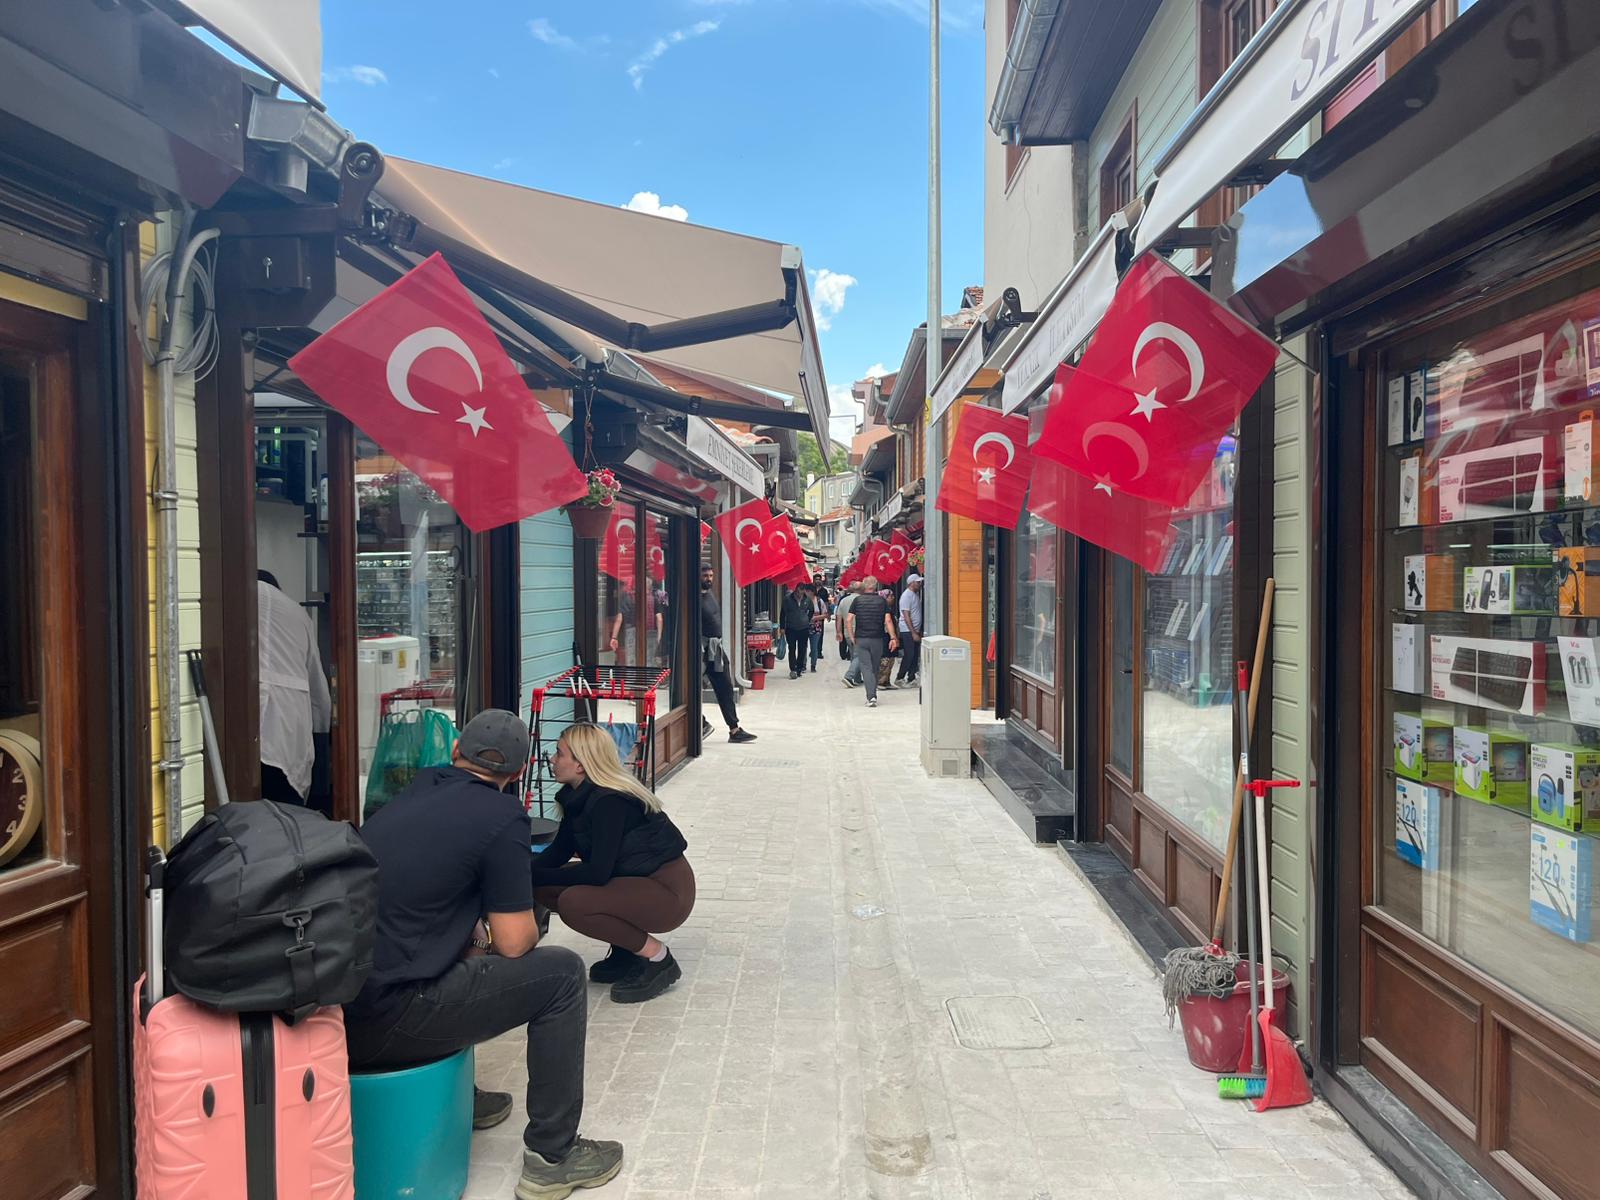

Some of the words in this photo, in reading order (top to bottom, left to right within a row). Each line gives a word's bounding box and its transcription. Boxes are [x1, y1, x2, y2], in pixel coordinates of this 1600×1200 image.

[12, 767, 23, 784] 2
[18, 795, 27, 811] 3
[6, 820, 17, 836] 4
[1539, 857, 1561, 883] 120
